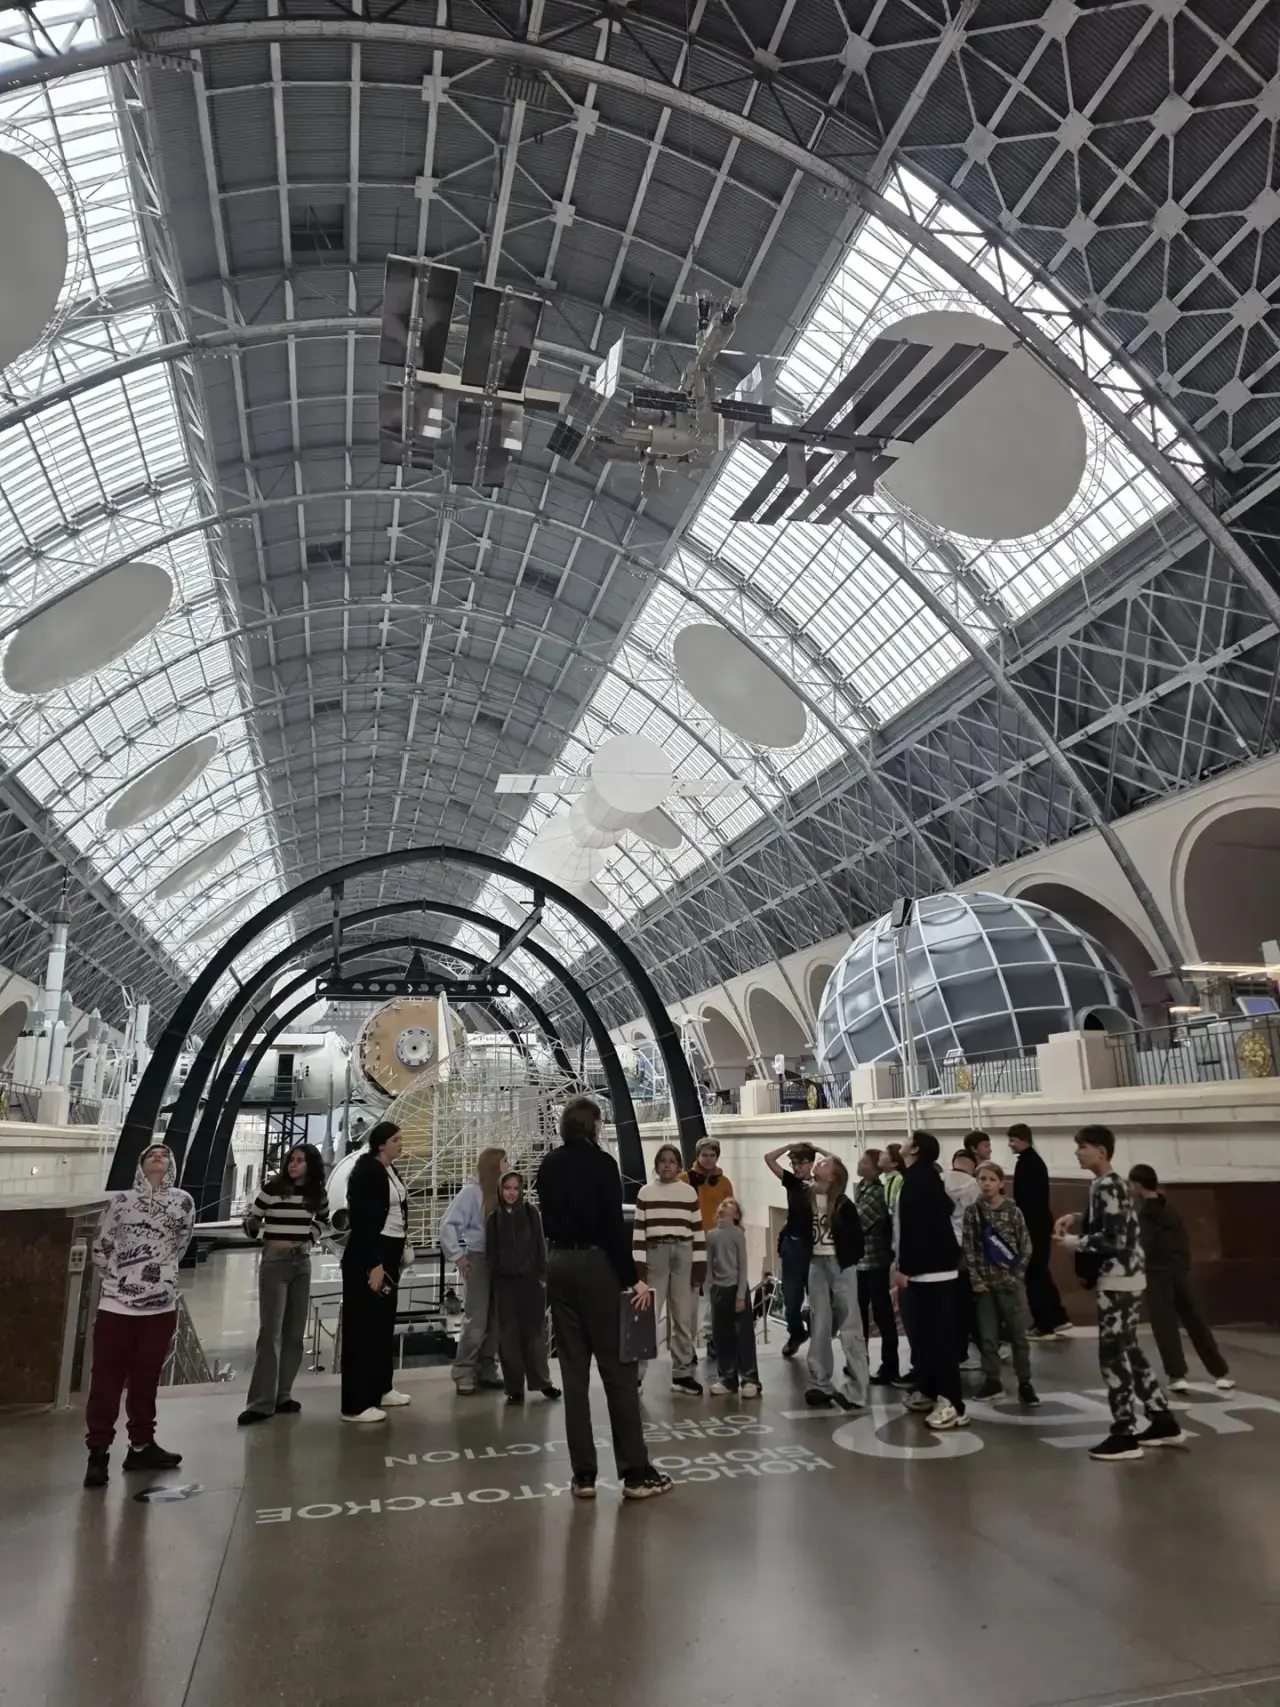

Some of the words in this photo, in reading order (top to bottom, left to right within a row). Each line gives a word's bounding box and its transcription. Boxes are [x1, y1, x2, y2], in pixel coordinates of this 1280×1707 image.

[384, 1424, 774, 1467] CONSRUCTION
[652, 1445, 814, 1468] БЮРО
[256, 1457, 835, 1524] КОНСТУКТОРСКОЕ
